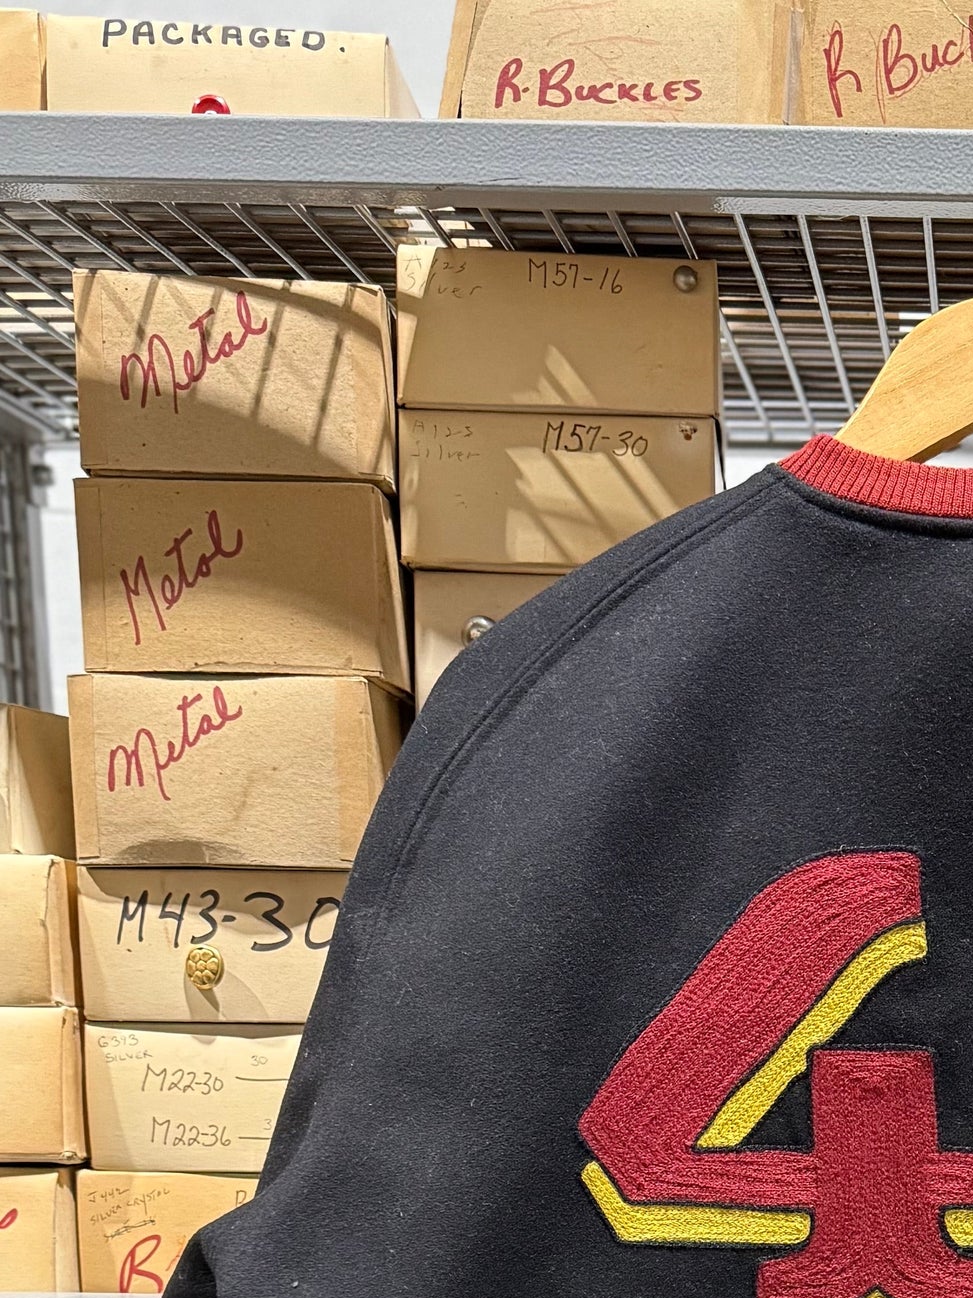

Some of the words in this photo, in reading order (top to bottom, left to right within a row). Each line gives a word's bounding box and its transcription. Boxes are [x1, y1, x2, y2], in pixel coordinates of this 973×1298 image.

[823, 21, 861, 118] R
[527, 256, 624, 295] M57-16
[119, 290, 268, 415] Metal
[542, 421, 649, 457] M57-30
[107, 685, 244, 801] Metal
[117, 889, 344, 951] M43-30
[141, 1063, 224, 1096] M22-30
[150, 1116, 232, 1147] M22-36
